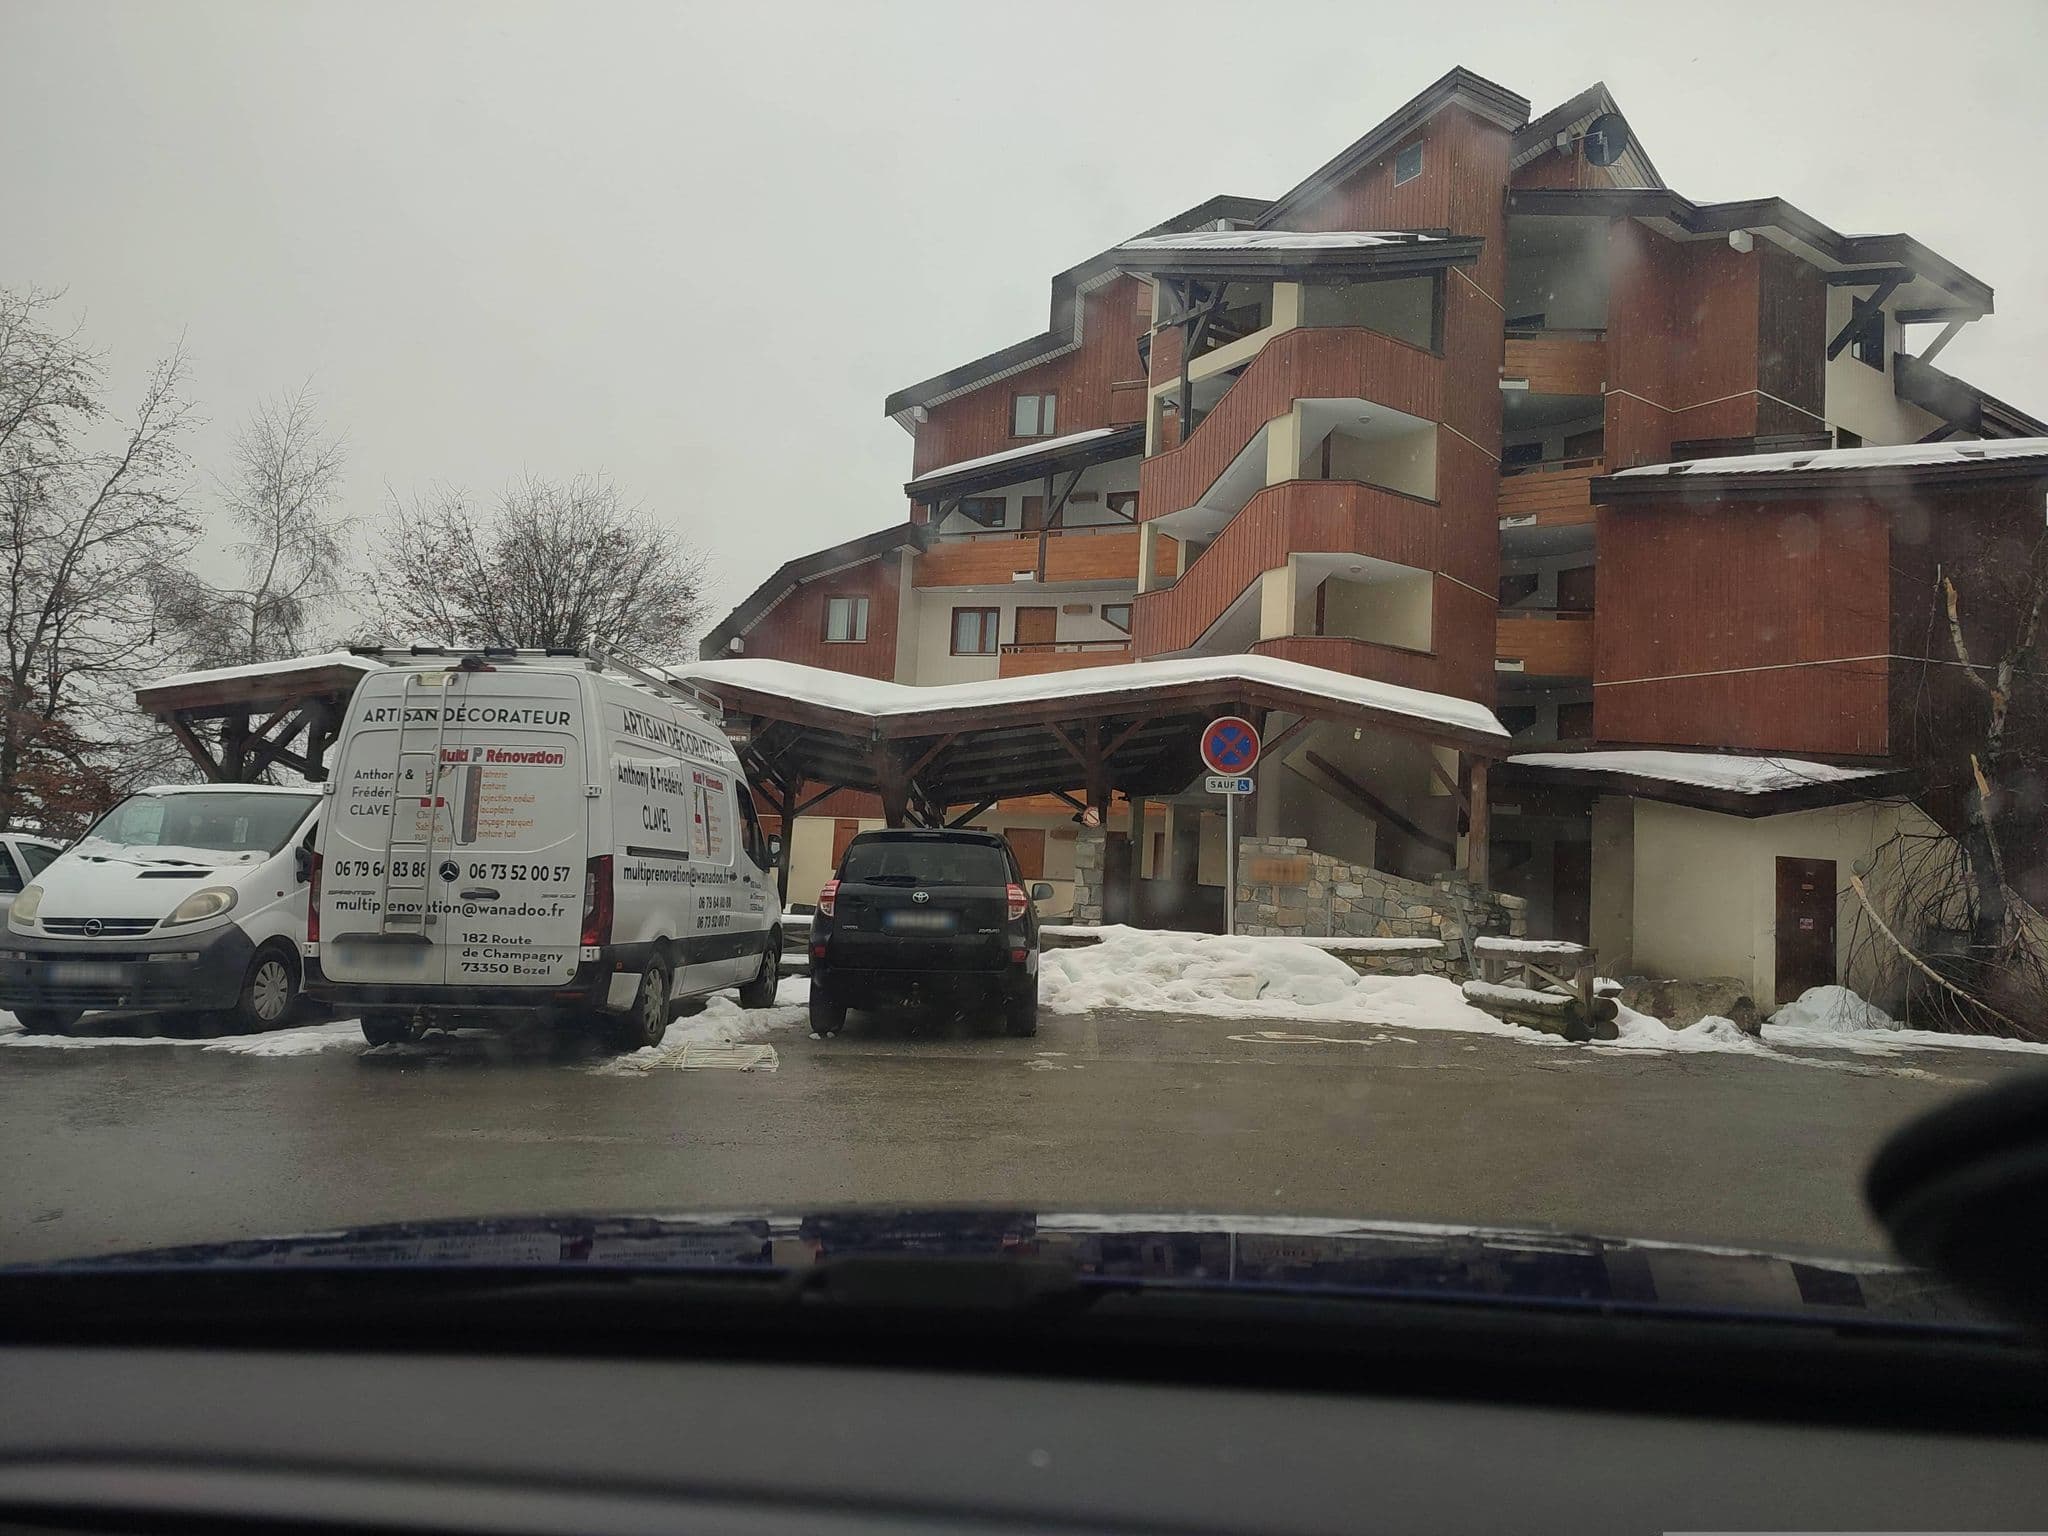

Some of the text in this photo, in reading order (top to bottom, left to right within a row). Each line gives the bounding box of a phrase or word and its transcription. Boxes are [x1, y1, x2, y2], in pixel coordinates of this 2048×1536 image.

[362, 703, 571, 726] ARTISAN DÉCORATEUR
[622, 708, 667, 746] ARTISAN
[486, 747, 564, 765] Rénovation
[404, 768, 415, 780] &
[617, 758, 649, 796] Anthony
[649, 766, 656, 790] &
[351, 785, 400, 798] Frédéri
[1210, 780, 1236, 789] SAUF
[349, 804, 398, 816] CLAVE
[642, 804, 672, 833] CLAVEL
[335, 860, 351, 877] 06
[353, 860, 369, 877] 79
[392, 861, 408, 878] 83
[469, 863, 571, 882] 06 73 52 00 57
[623, 860, 730, 893] multiprenovation@wanadoo.fr
[335, 896, 565, 917] multipenovtion@wanadoo.fr
[462, 933, 533, 945] 182 Route
[462, 947, 564, 963] de Champagny
[461, 962, 551, 975] 73350 Bozel
